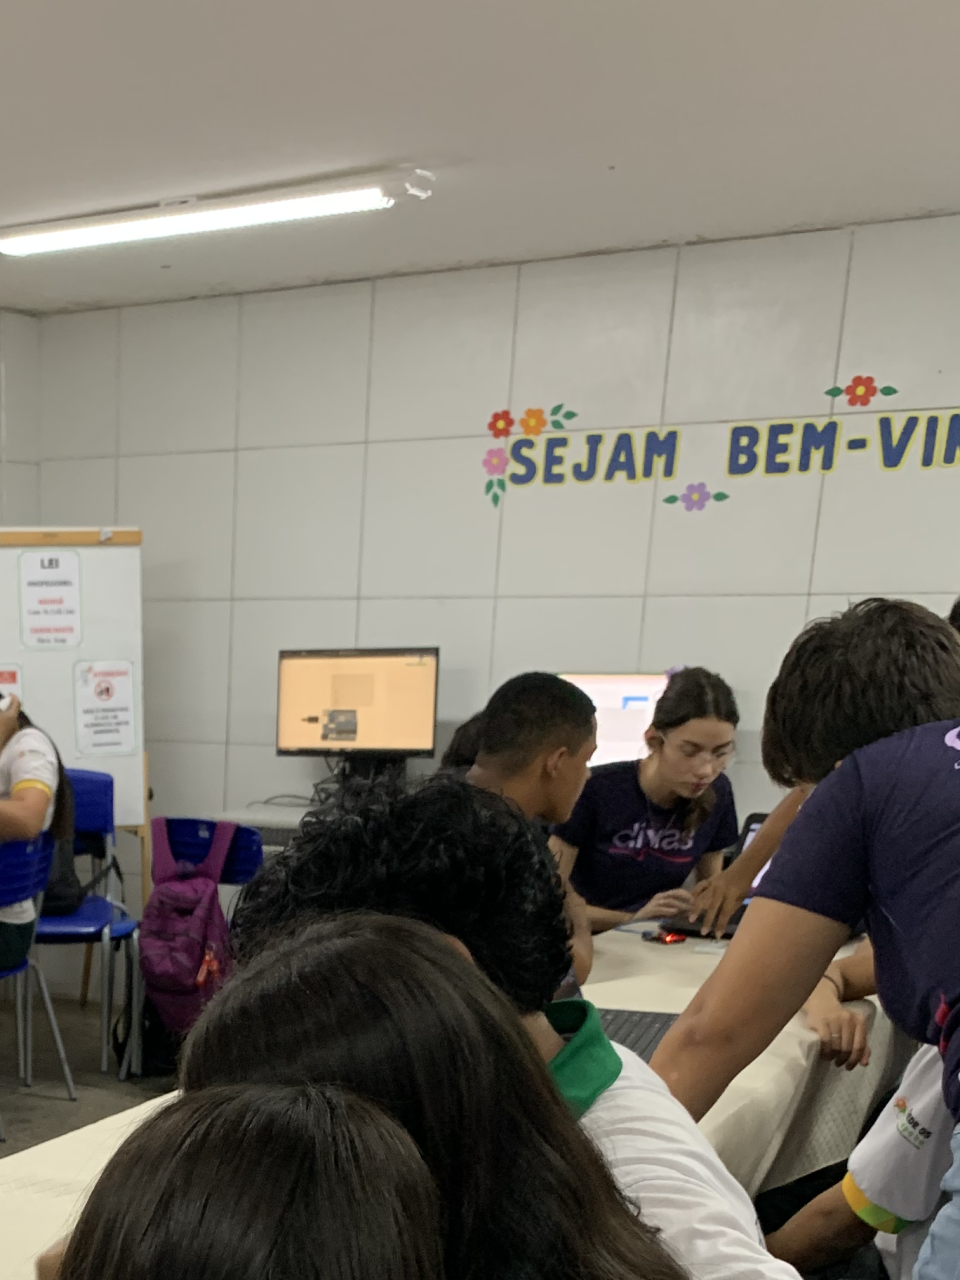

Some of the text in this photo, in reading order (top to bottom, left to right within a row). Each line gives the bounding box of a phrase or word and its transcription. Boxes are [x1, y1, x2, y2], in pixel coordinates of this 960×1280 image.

[509, 431, 678, 485] SEJAM
[40, 558, 60, 570] LEI
[612, 821, 695, 850] divas
